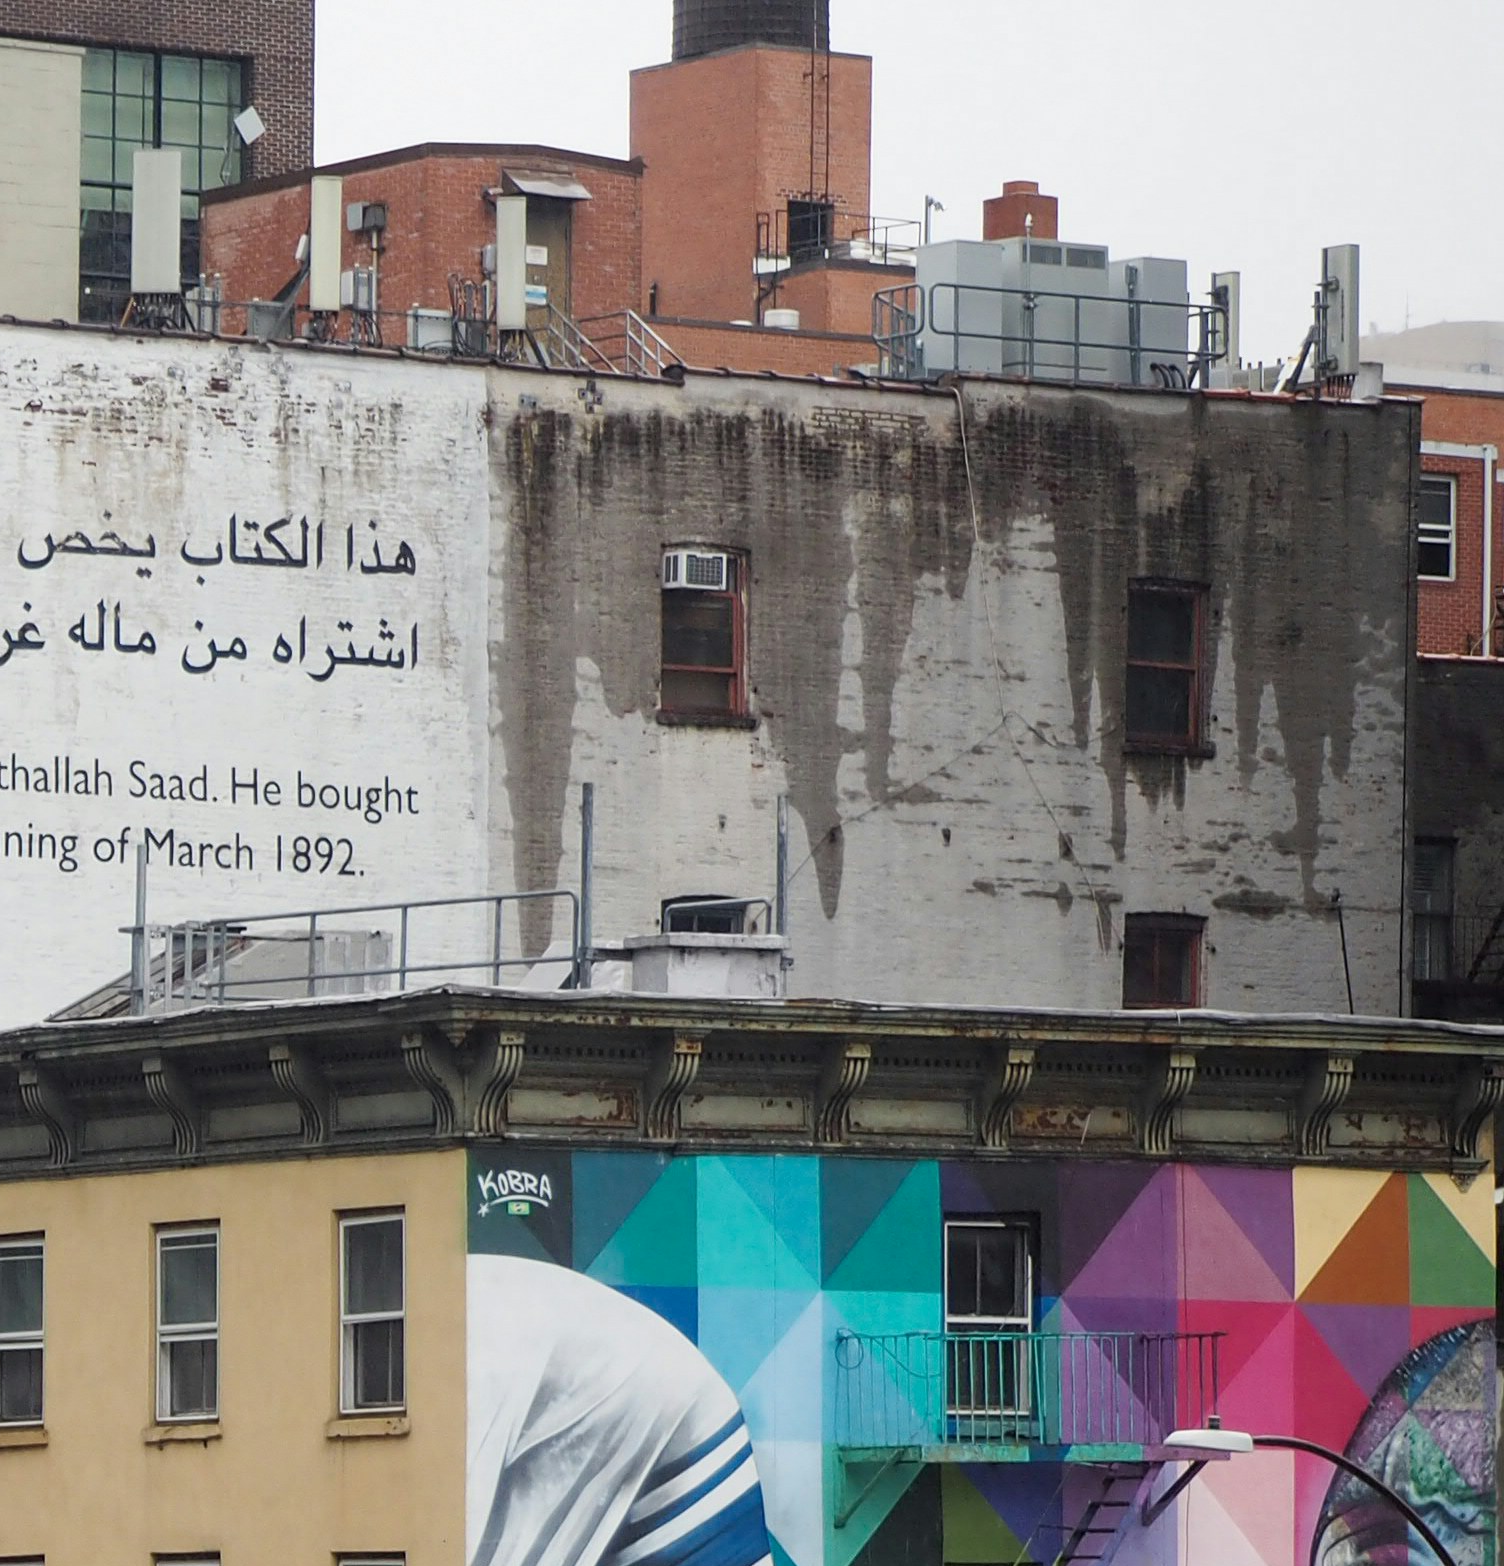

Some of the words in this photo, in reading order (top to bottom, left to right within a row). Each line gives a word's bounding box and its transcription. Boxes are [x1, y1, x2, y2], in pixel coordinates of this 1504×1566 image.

[18, 509, 155, 580] يخص
[180, 513, 324, 586] الكتاب
[347, 520, 416, 575] هذا
[68, 598, 156, 656] ماله
[181, 619, 247, 673] من
[272, 616, 417, 683] اشتراه
[128, 759, 218, 803] Saad.
[230, 766, 282, 807] He
[296, 770, 419, 825] bought
[93, 826, 131, 863] of
[142, 827, 254, 871] March
[274, 834, 365, 877] 1892.
[478, 1170, 552, 1200] KOBRA
